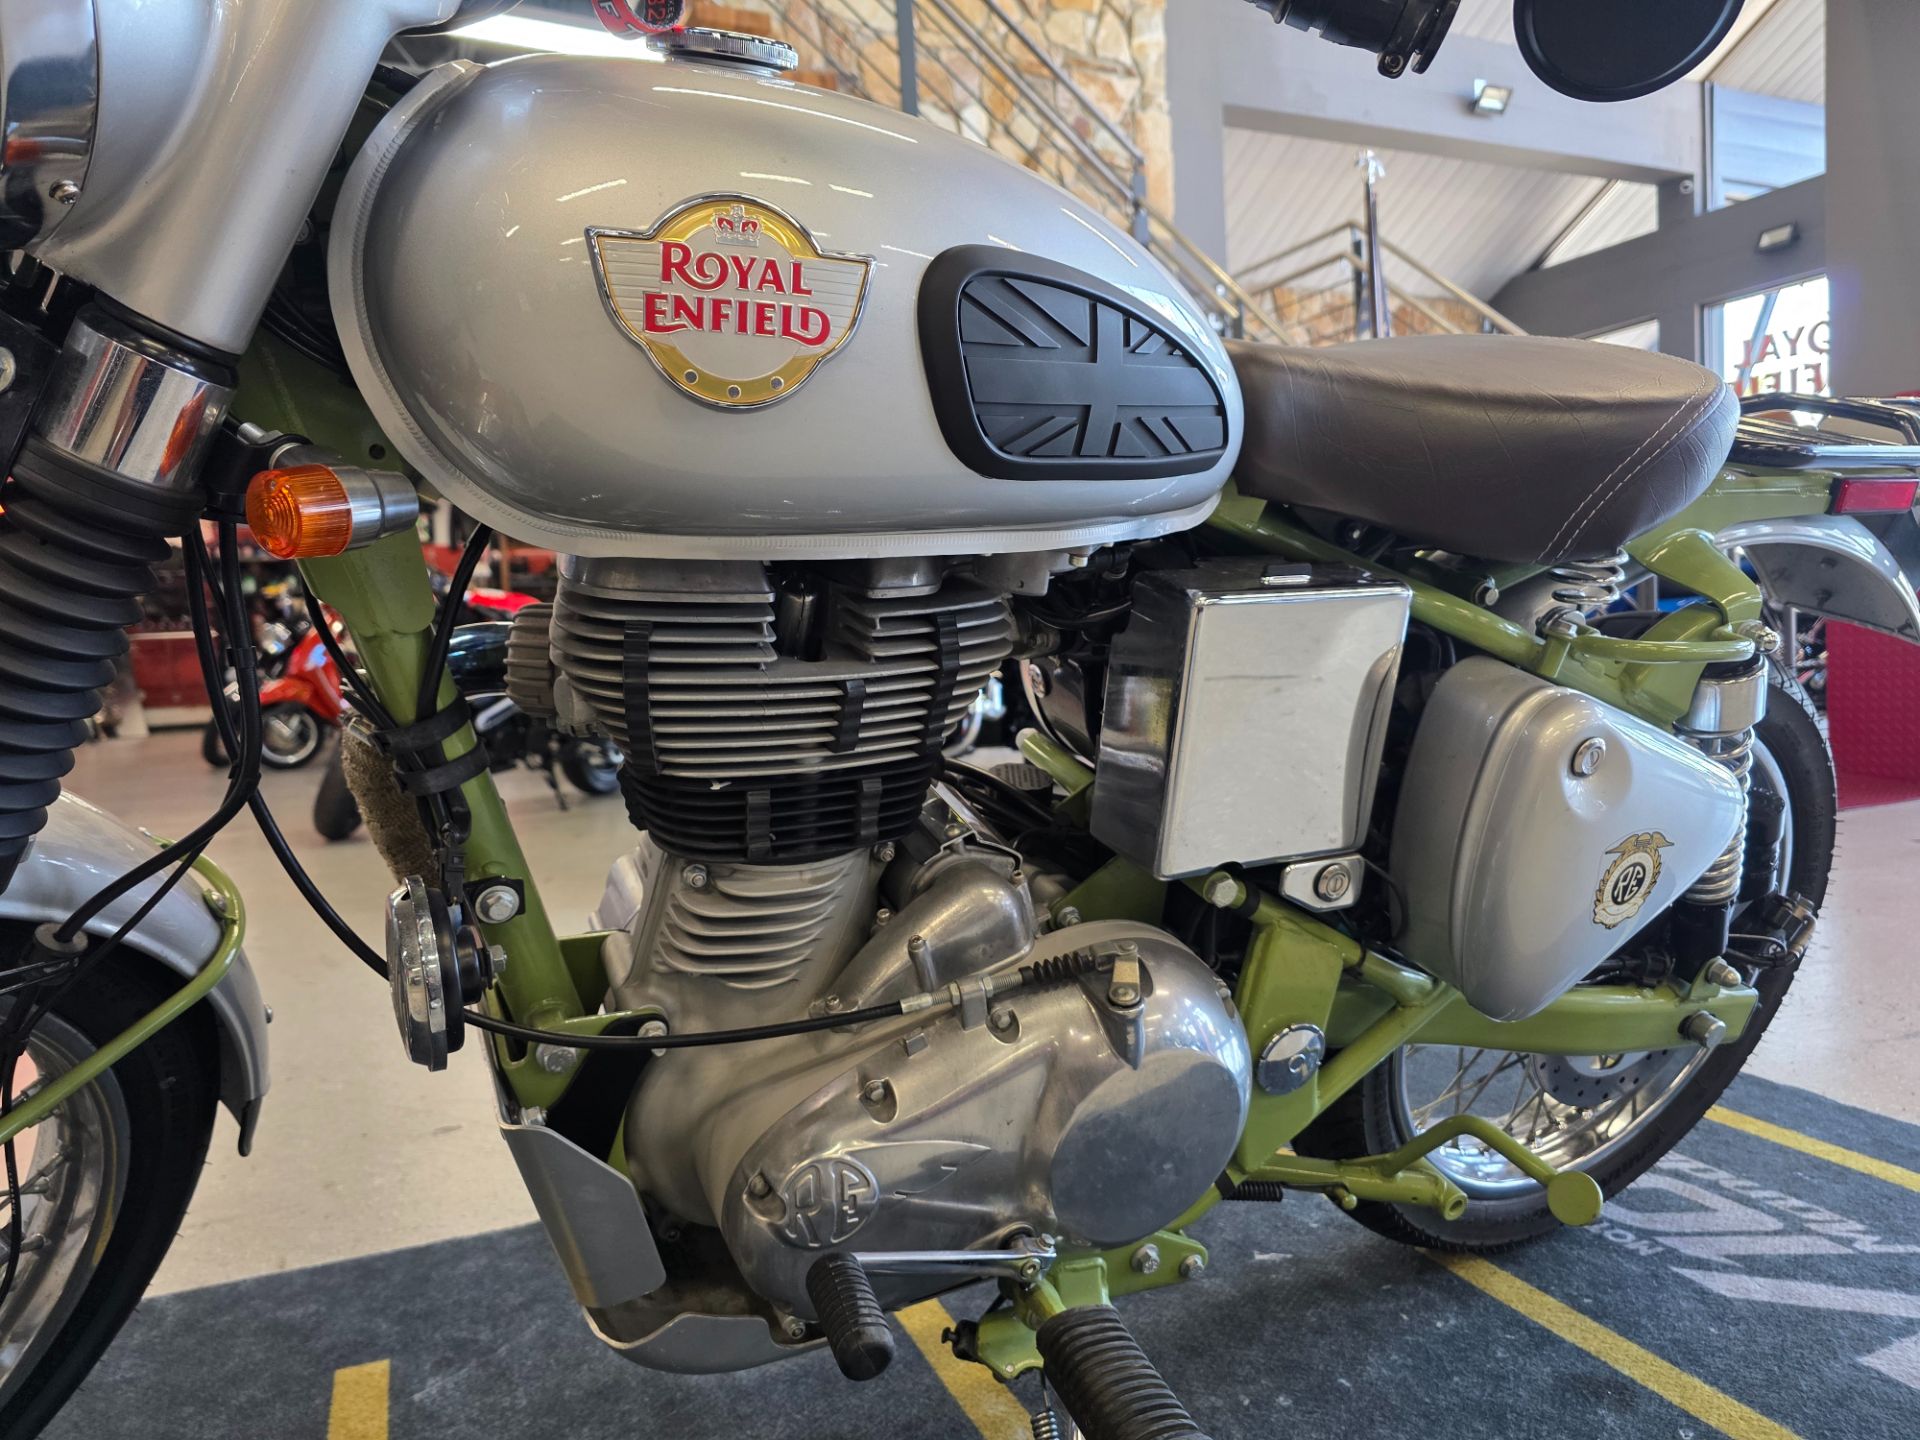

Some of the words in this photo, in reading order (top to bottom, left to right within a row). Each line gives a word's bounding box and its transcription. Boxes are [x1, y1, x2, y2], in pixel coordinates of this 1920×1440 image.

[659, 240, 813, 297] ROYAL
[642, 290, 832, 347] ENFIELD
[785, 1159, 874, 1248] RE
